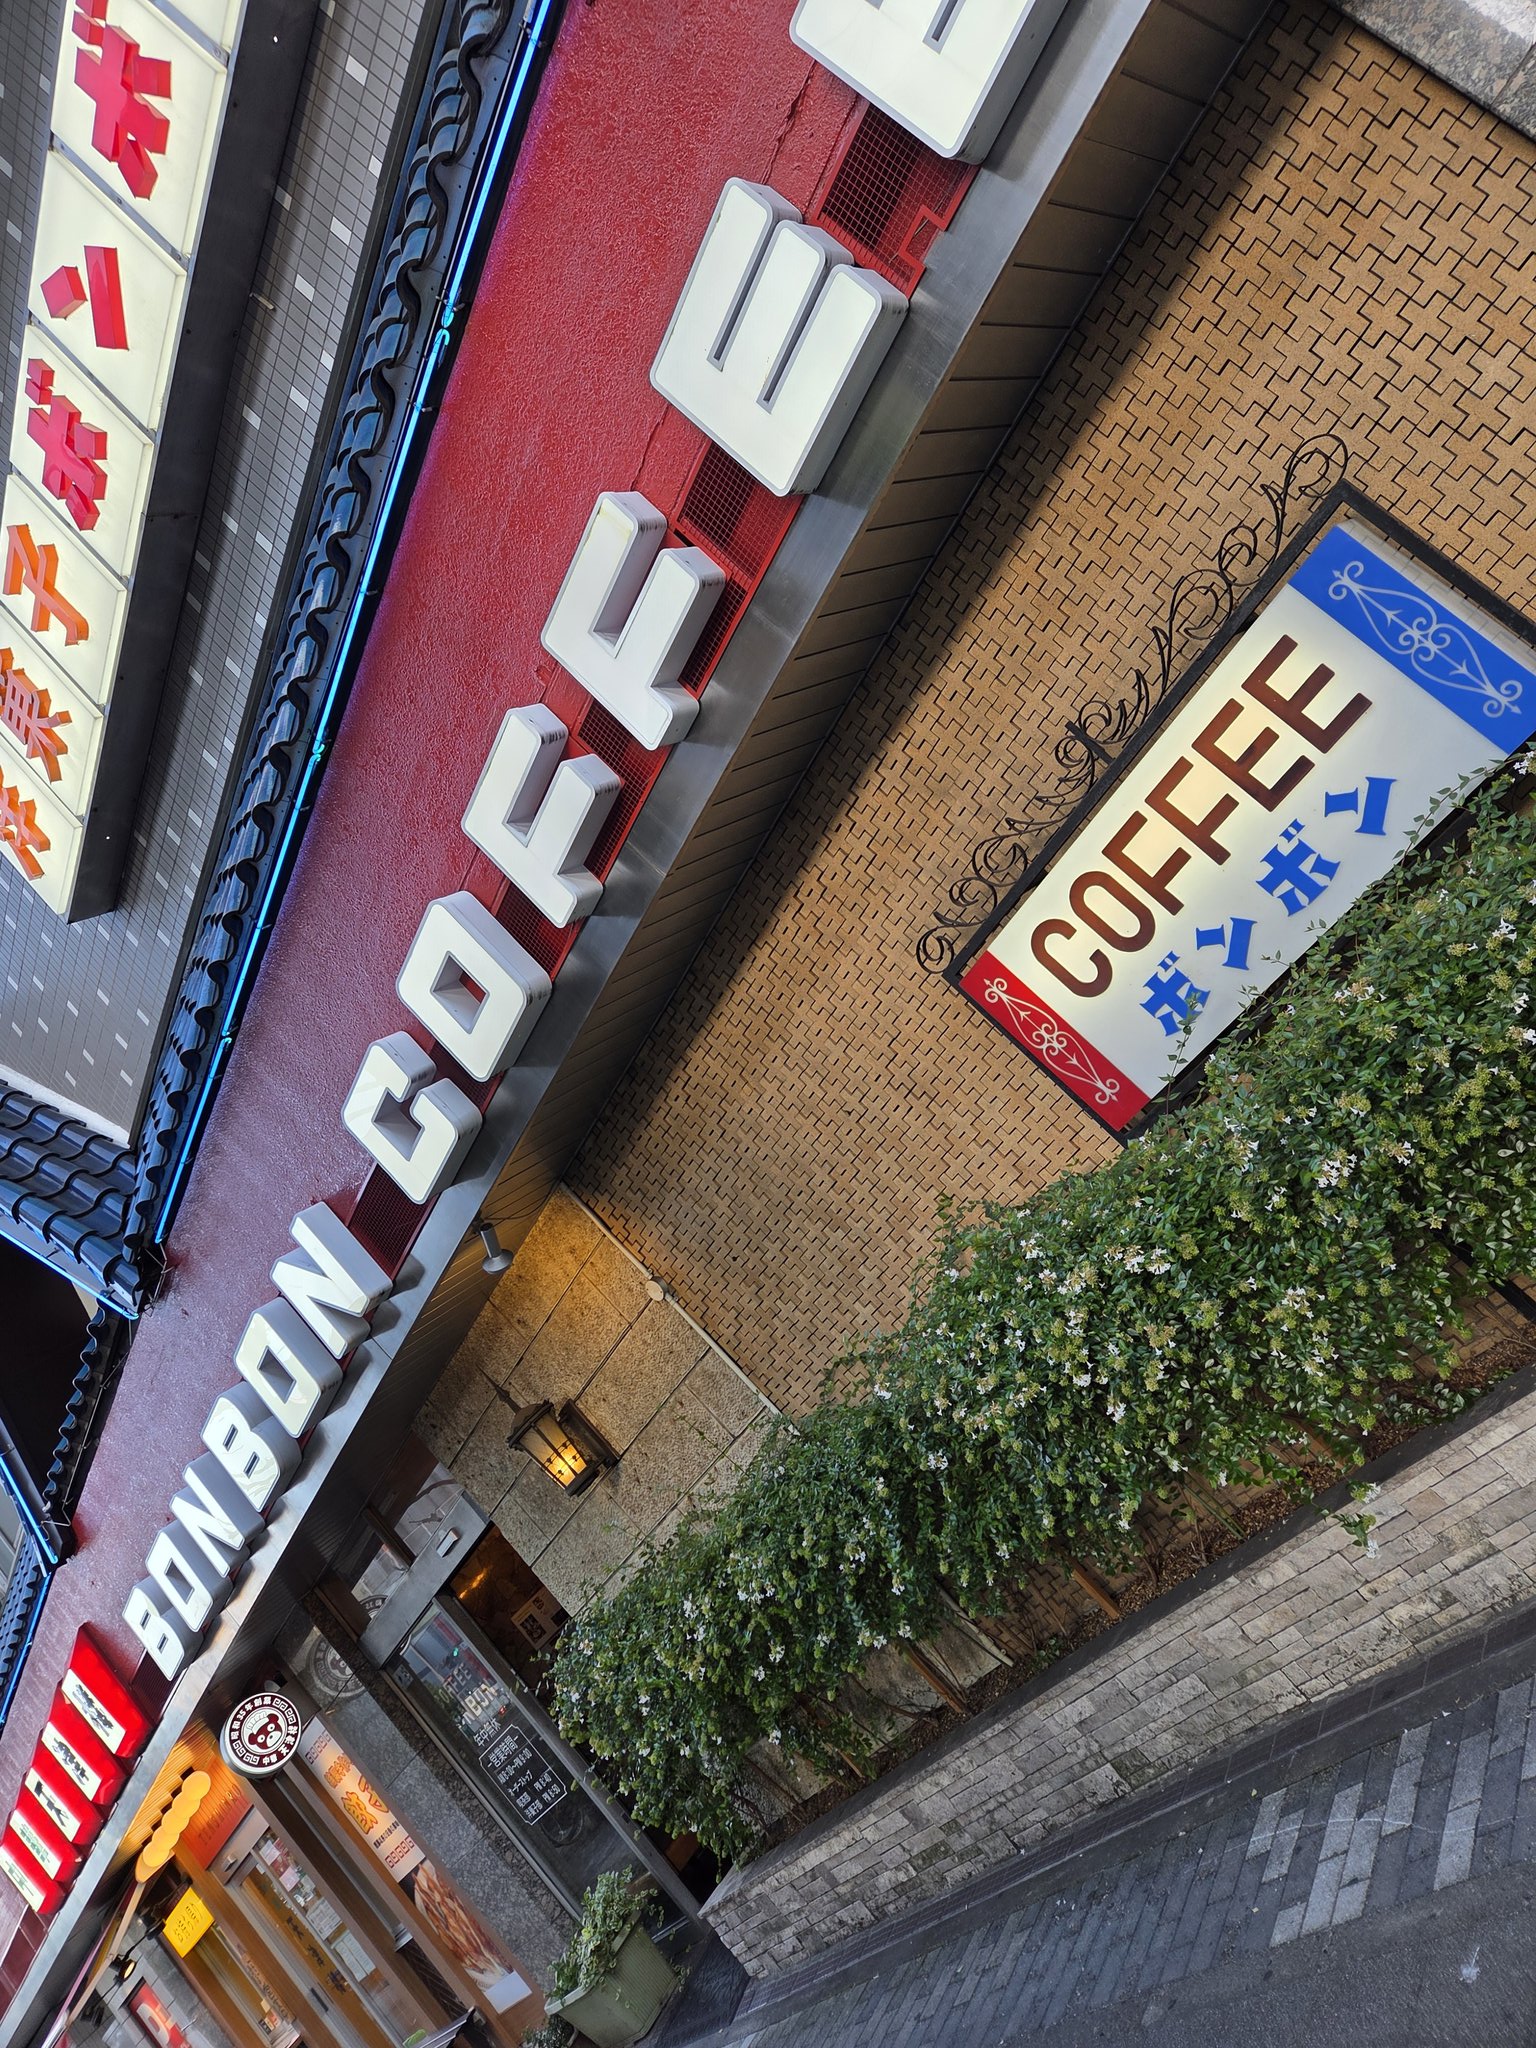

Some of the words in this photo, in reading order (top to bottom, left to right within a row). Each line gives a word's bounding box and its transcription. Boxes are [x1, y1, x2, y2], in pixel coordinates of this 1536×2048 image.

[1031, 634, 1372, 998] COFFEE
[1140, 776, 1398, 1037] ボンボン
[122, 1202, 388, 1681] BONBON
[473, 1717, 501, 1747] 年中無休
